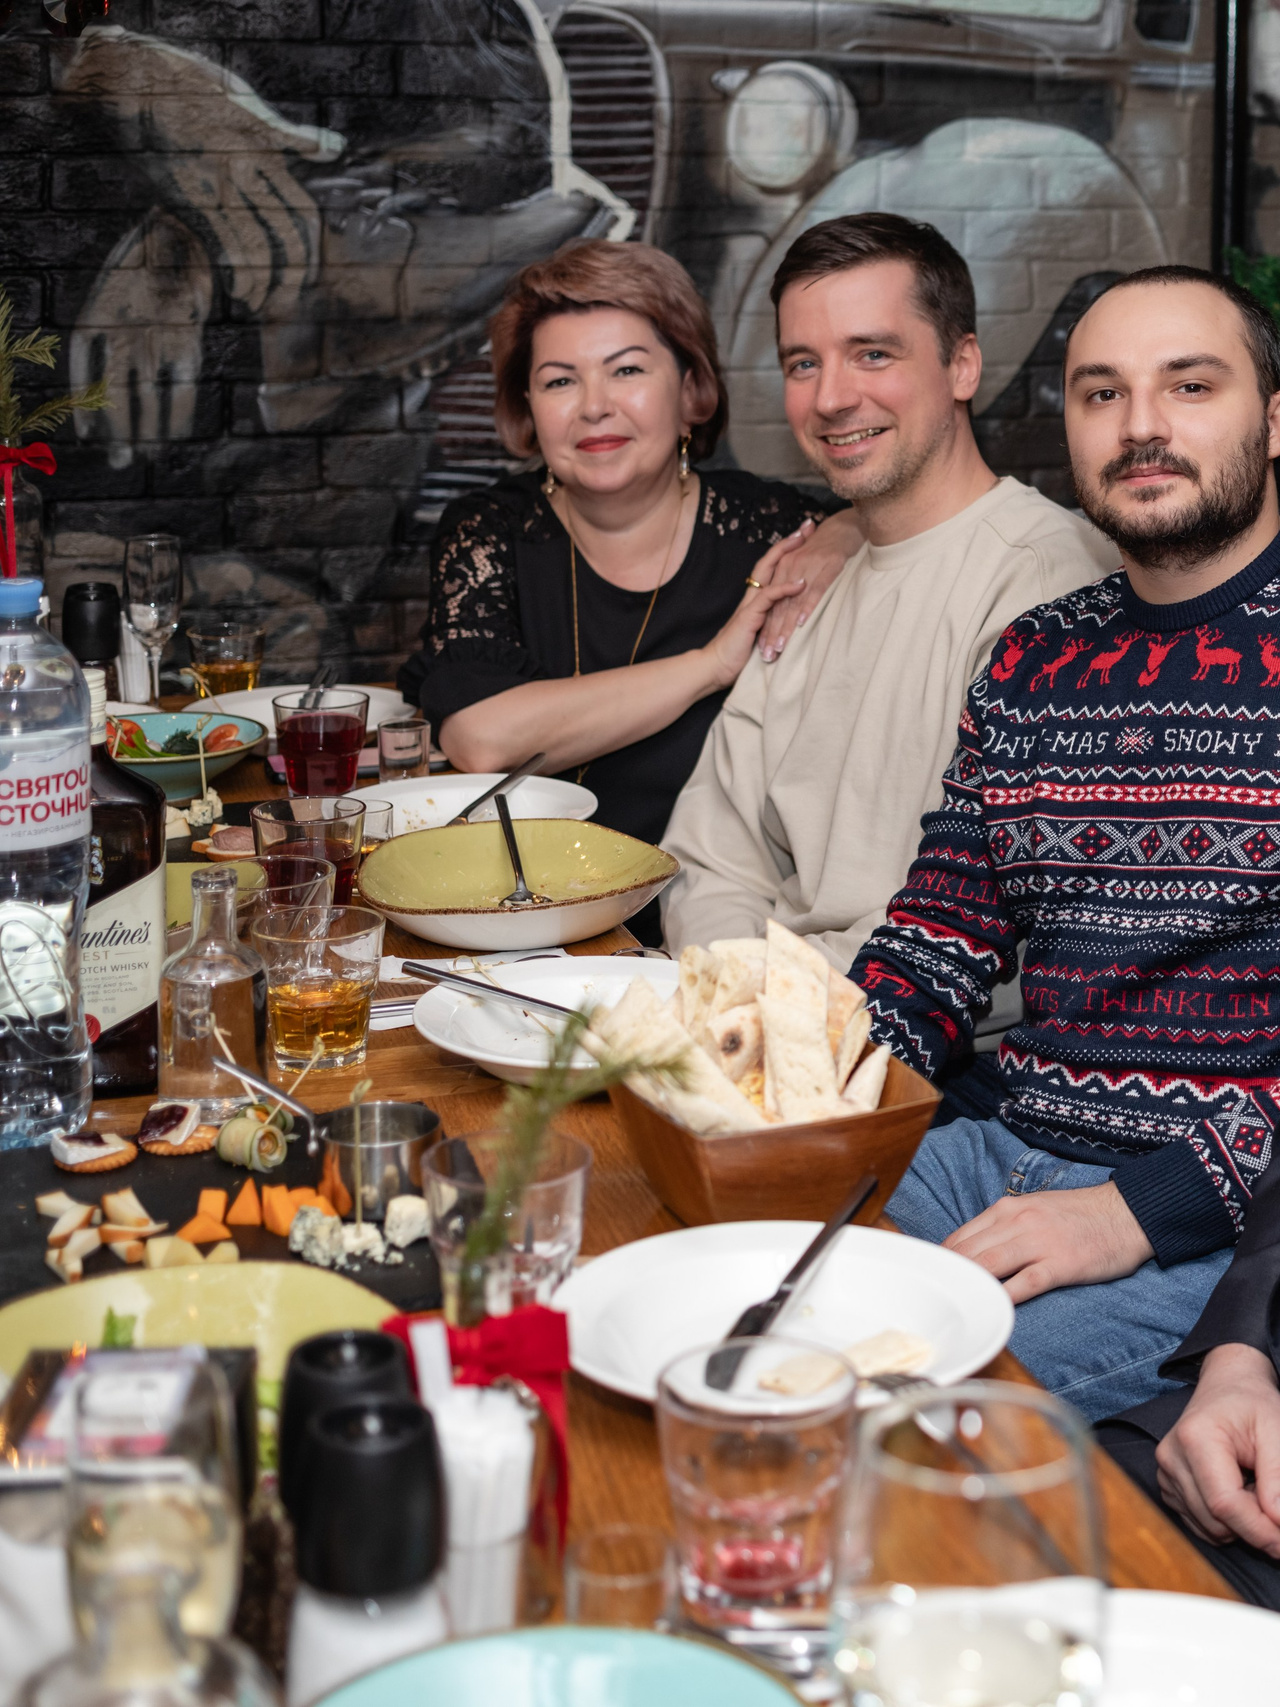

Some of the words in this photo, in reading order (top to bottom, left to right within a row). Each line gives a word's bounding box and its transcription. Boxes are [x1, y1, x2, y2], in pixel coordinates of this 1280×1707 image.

[1038, 728, 1109, 756] -MAS
[1163, 728, 1263, 756] SNOWY
[110, 961, 150, 972] WHISKY
[1083, 987, 1271, 1019] TWINKLIN
